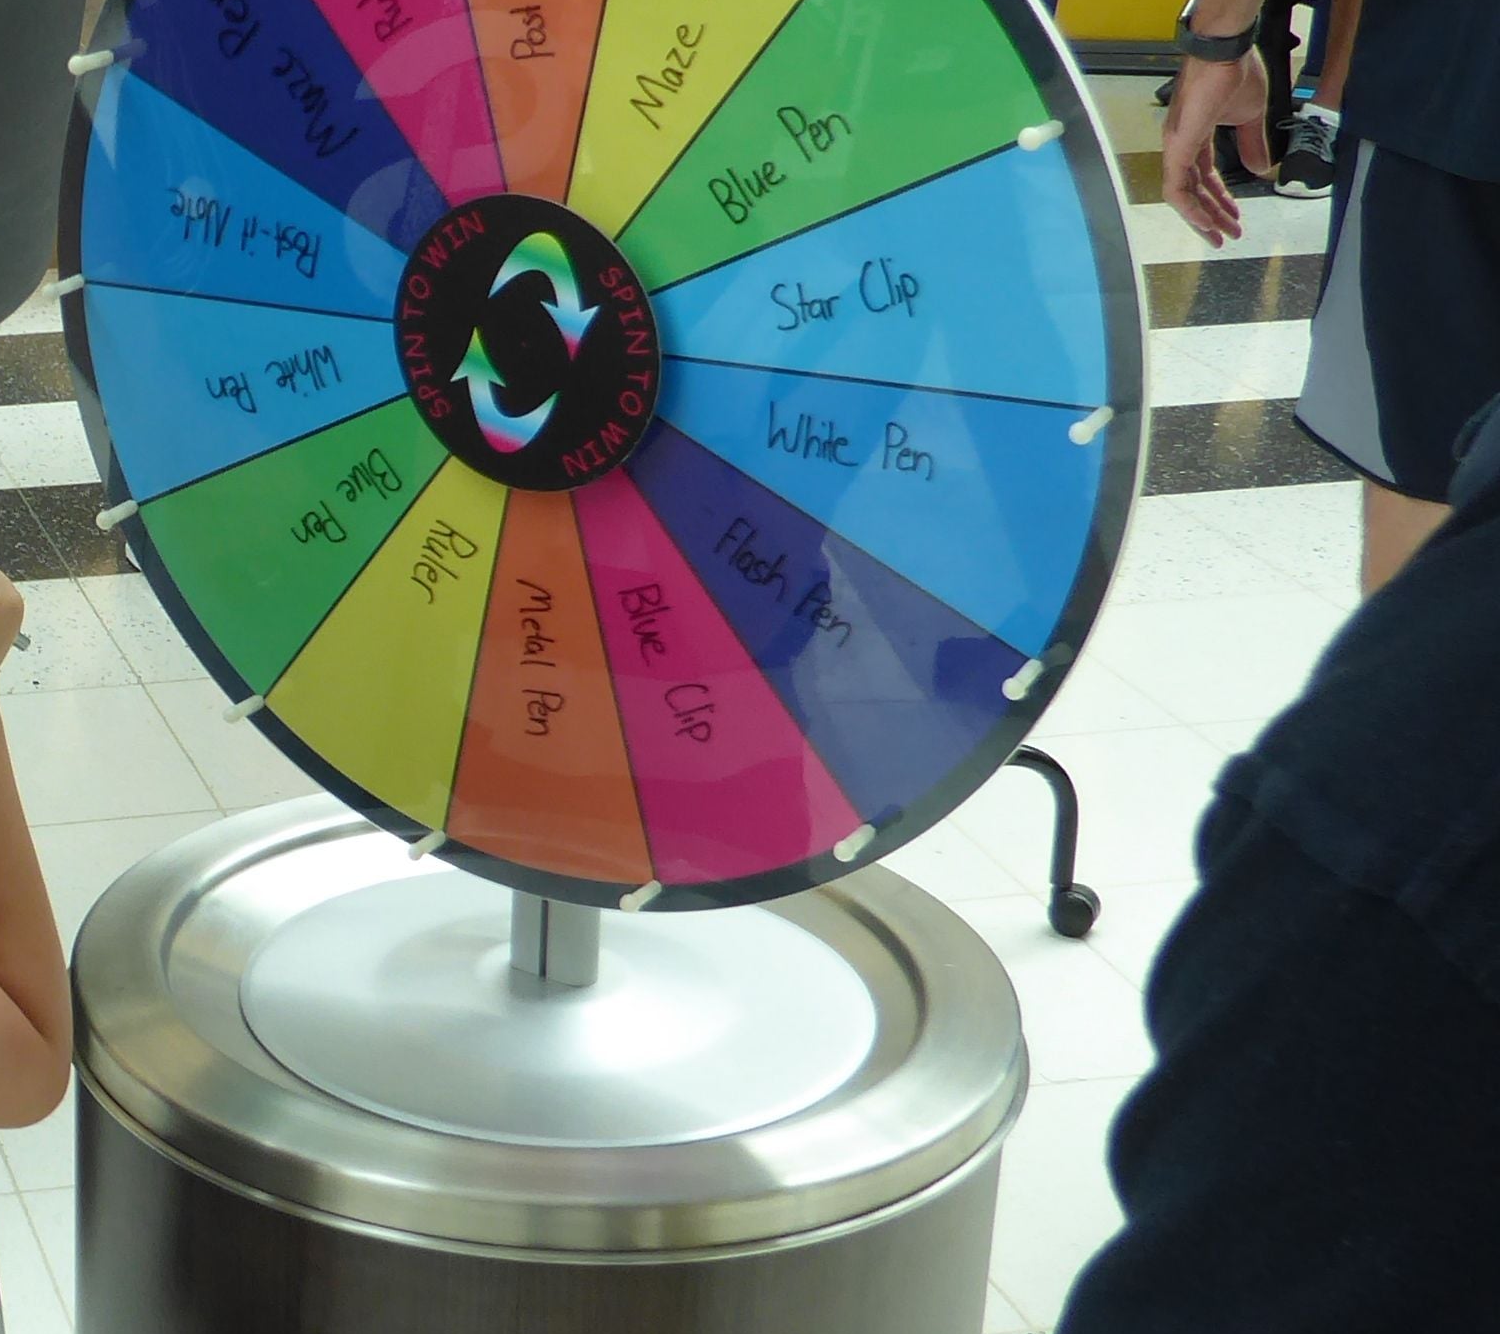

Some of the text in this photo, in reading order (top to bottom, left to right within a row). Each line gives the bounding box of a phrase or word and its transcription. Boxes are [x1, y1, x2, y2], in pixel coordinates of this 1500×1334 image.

[269, 42, 362, 161] Maze
[630, 23, 705, 131] Maze
[168, 185, 232, 249] Note
[707, 106, 852, 225] Blue Pen
[402, 210, 486, 419] SPIN TO WIN
[769, 255, 921, 332] Star Clip
[205, 343, 343, 415] White Pen
[561, 265, 651, 478] SPIN TO WIN
[290, 446, 403, 548] Blue Pen
[767, 401, 936, 482] White Pen
[410, 517, 480, 605] Ruler
[713, 515, 853, 648] Flash Pen
[516, 575, 566, 738] Metal Pen
[616, 582, 713, 745] Blue Clip
